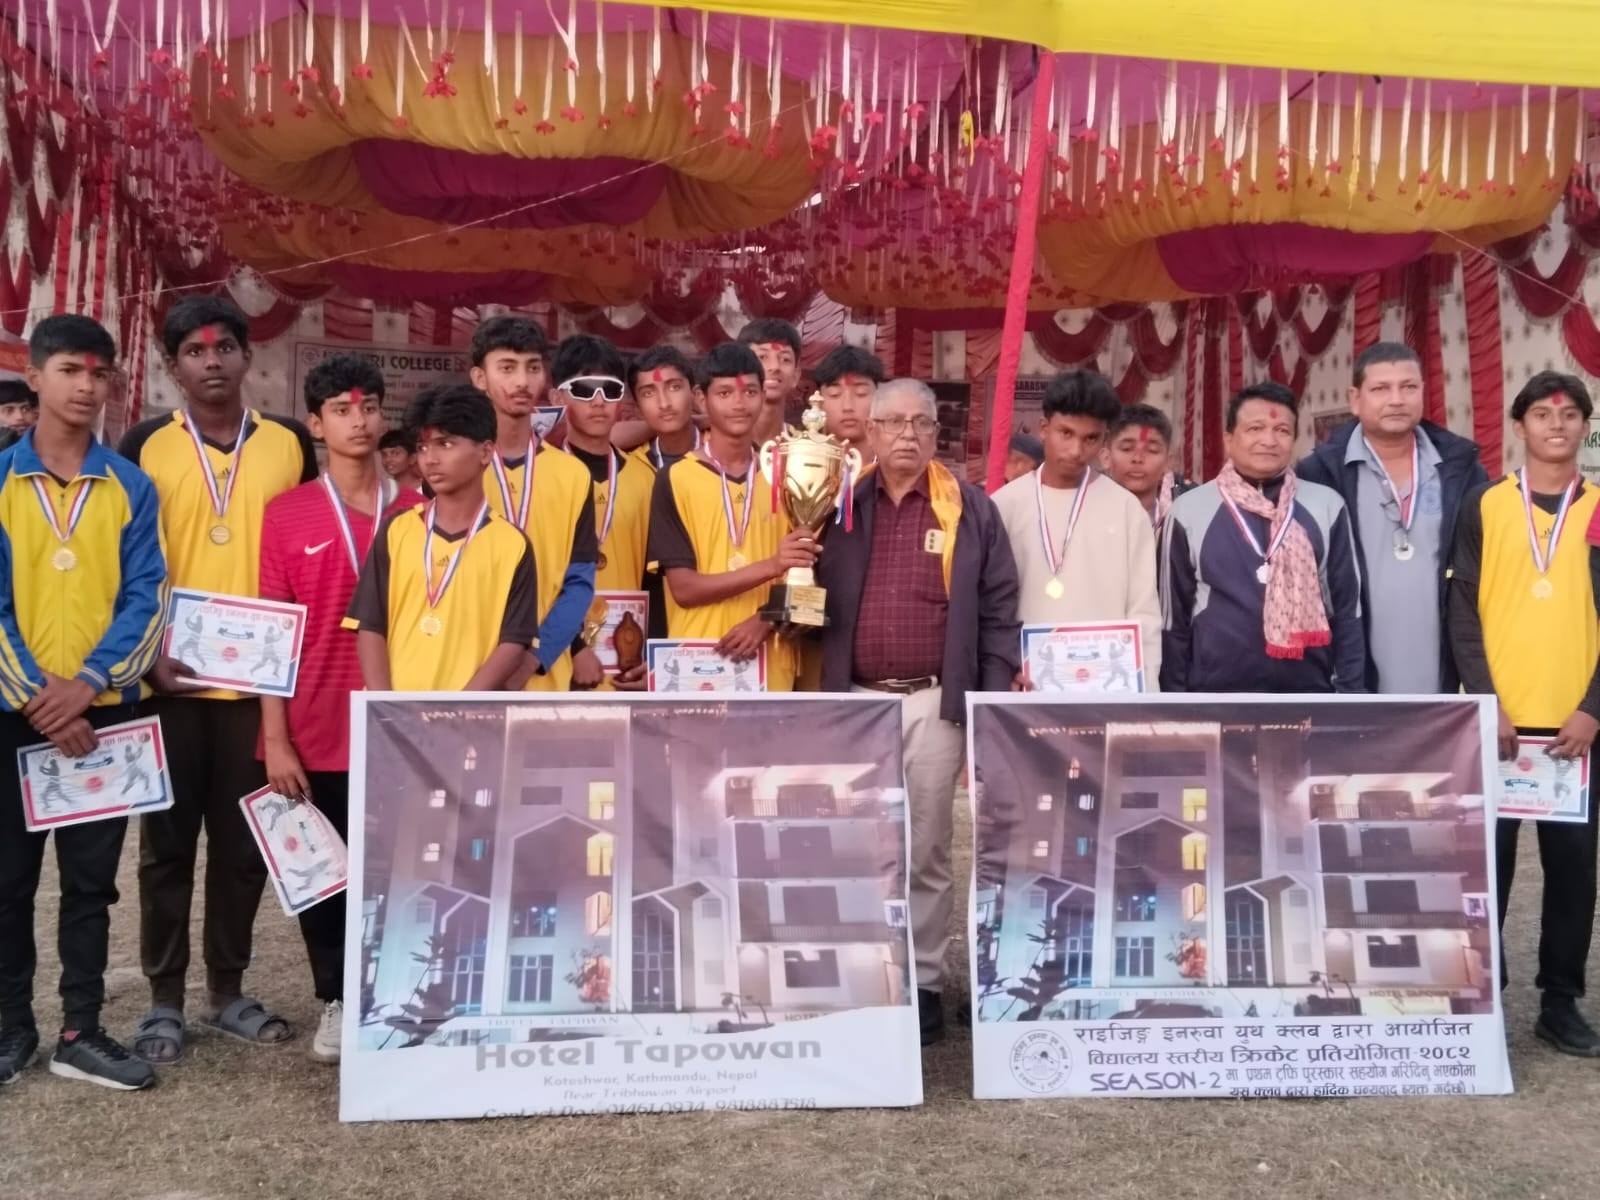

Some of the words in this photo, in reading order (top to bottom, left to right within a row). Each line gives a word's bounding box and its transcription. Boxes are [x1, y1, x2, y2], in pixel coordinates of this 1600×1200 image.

[390, 355, 453, 372] COLLEGE
[1161, 1025, 1224, 1042] इनरुवा
[1234, 1025, 1265, 1044] युथ
[1276, 1024, 1322, 1039] क्लब
[1331, 1023, 1374, 1039] द्वारा
[1384, 1018, 1474, 1036] आयोजित
[475, 1040, 594, 1071] Hotel
[614, 1037, 822, 1070] Tapowan
[1087, 1048, 1160, 1066] विद्यालय
[1166, 1048, 1224, 1065] स्तरीय
[1231, 1044, 1299, 1063] क्रिकेट
[543, 1075, 620, 1087] Koteshwar,
[626, 1072, 711, 1085] Kathmandu,
[716, 1069, 758, 1082] Nepal
[685, 1084, 737, 1097] Airport
